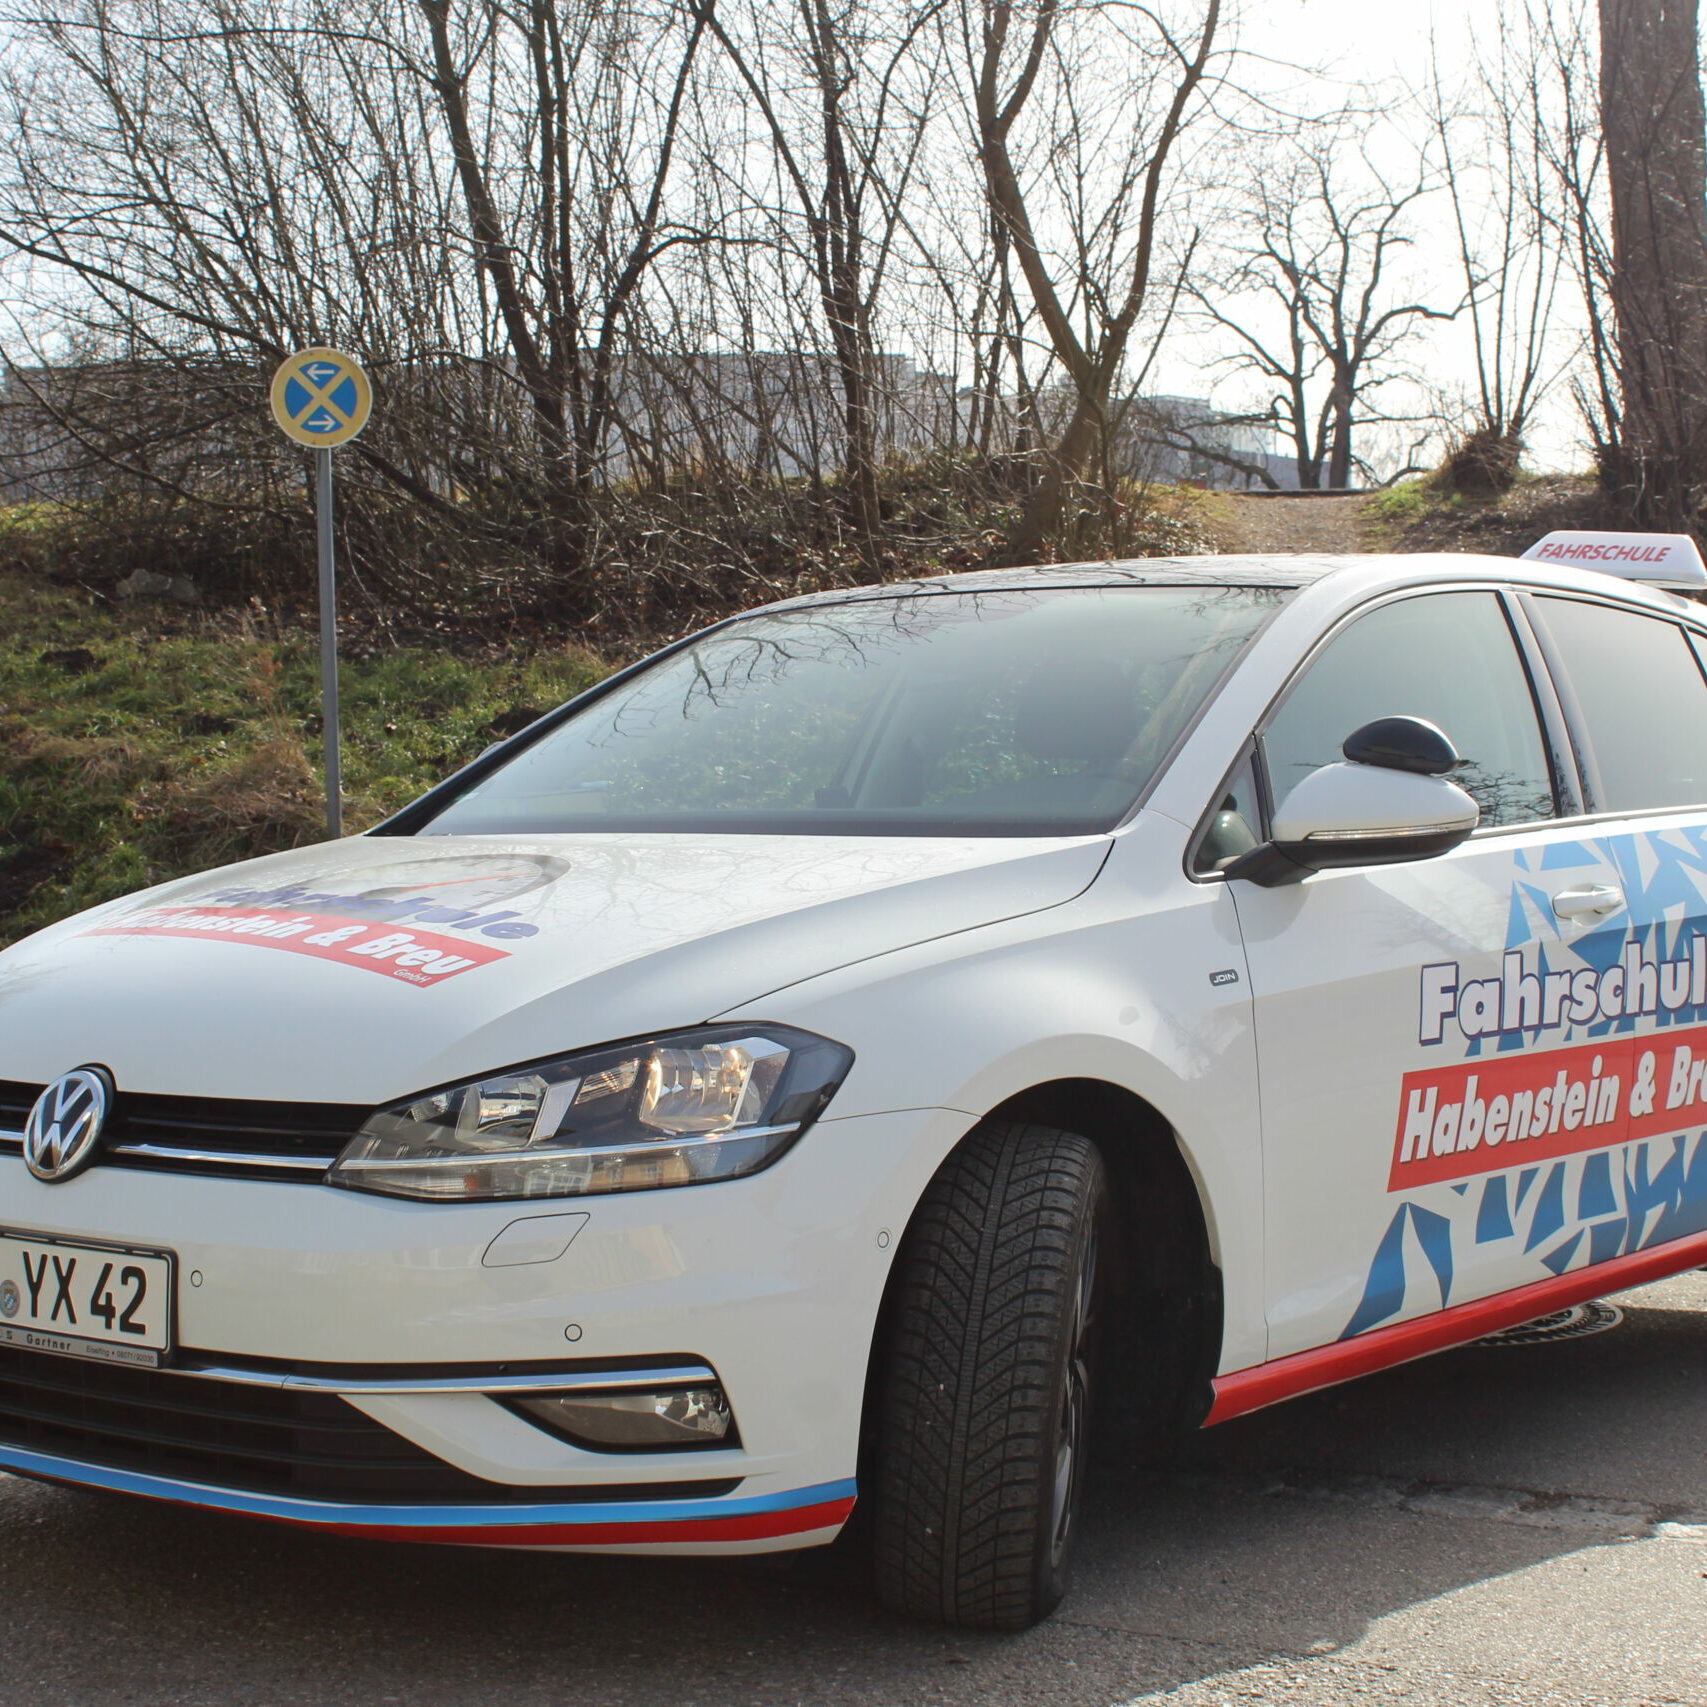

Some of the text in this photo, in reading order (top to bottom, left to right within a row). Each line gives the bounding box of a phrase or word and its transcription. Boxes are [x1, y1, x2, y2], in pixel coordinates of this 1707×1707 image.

[1536, 543, 1671, 563] FAHRSCHULE
[303, 925, 369, 948] &
[345, 933, 477, 975] Breu
[1213, 972, 1236, 984] JOIN
[1400, 1054, 1620, 1163] Habenstein
[1629, 1050, 1656, 1118] &
[22, 1251, 146, 1335] YX 42
